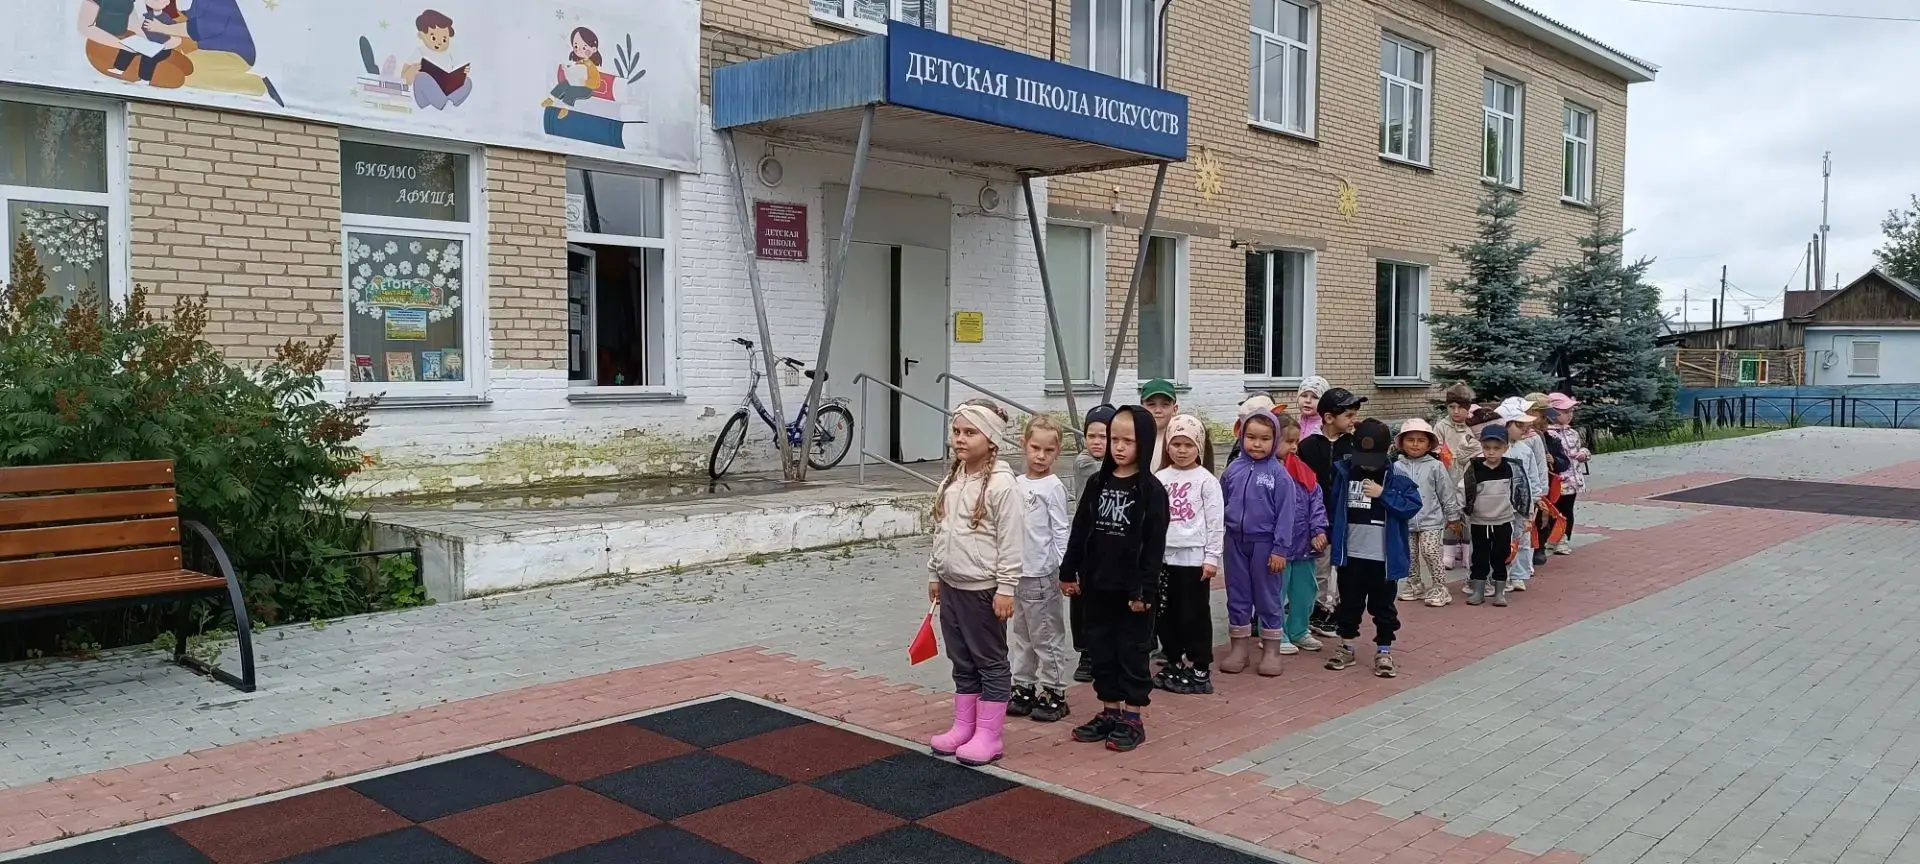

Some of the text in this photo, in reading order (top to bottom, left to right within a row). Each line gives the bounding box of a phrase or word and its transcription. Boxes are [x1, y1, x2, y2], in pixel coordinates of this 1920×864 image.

[906, 51, 1179, 136] ДЕТСКАЯ ШКОЛА ИСКУССТВ
[355, 161, 416, 180] БИБЛИО
[396, 188, 455, 207] АФИША
[764, 228, 799, 238] ДЕТСКАЯ
[768, 238, 797, 247] ШКОЛА
[762, 247, 803, 257] ИСКУССТВ
[1163, 481, 1192, 499] irl
[1097, 490, 1136, 525] PUNK
